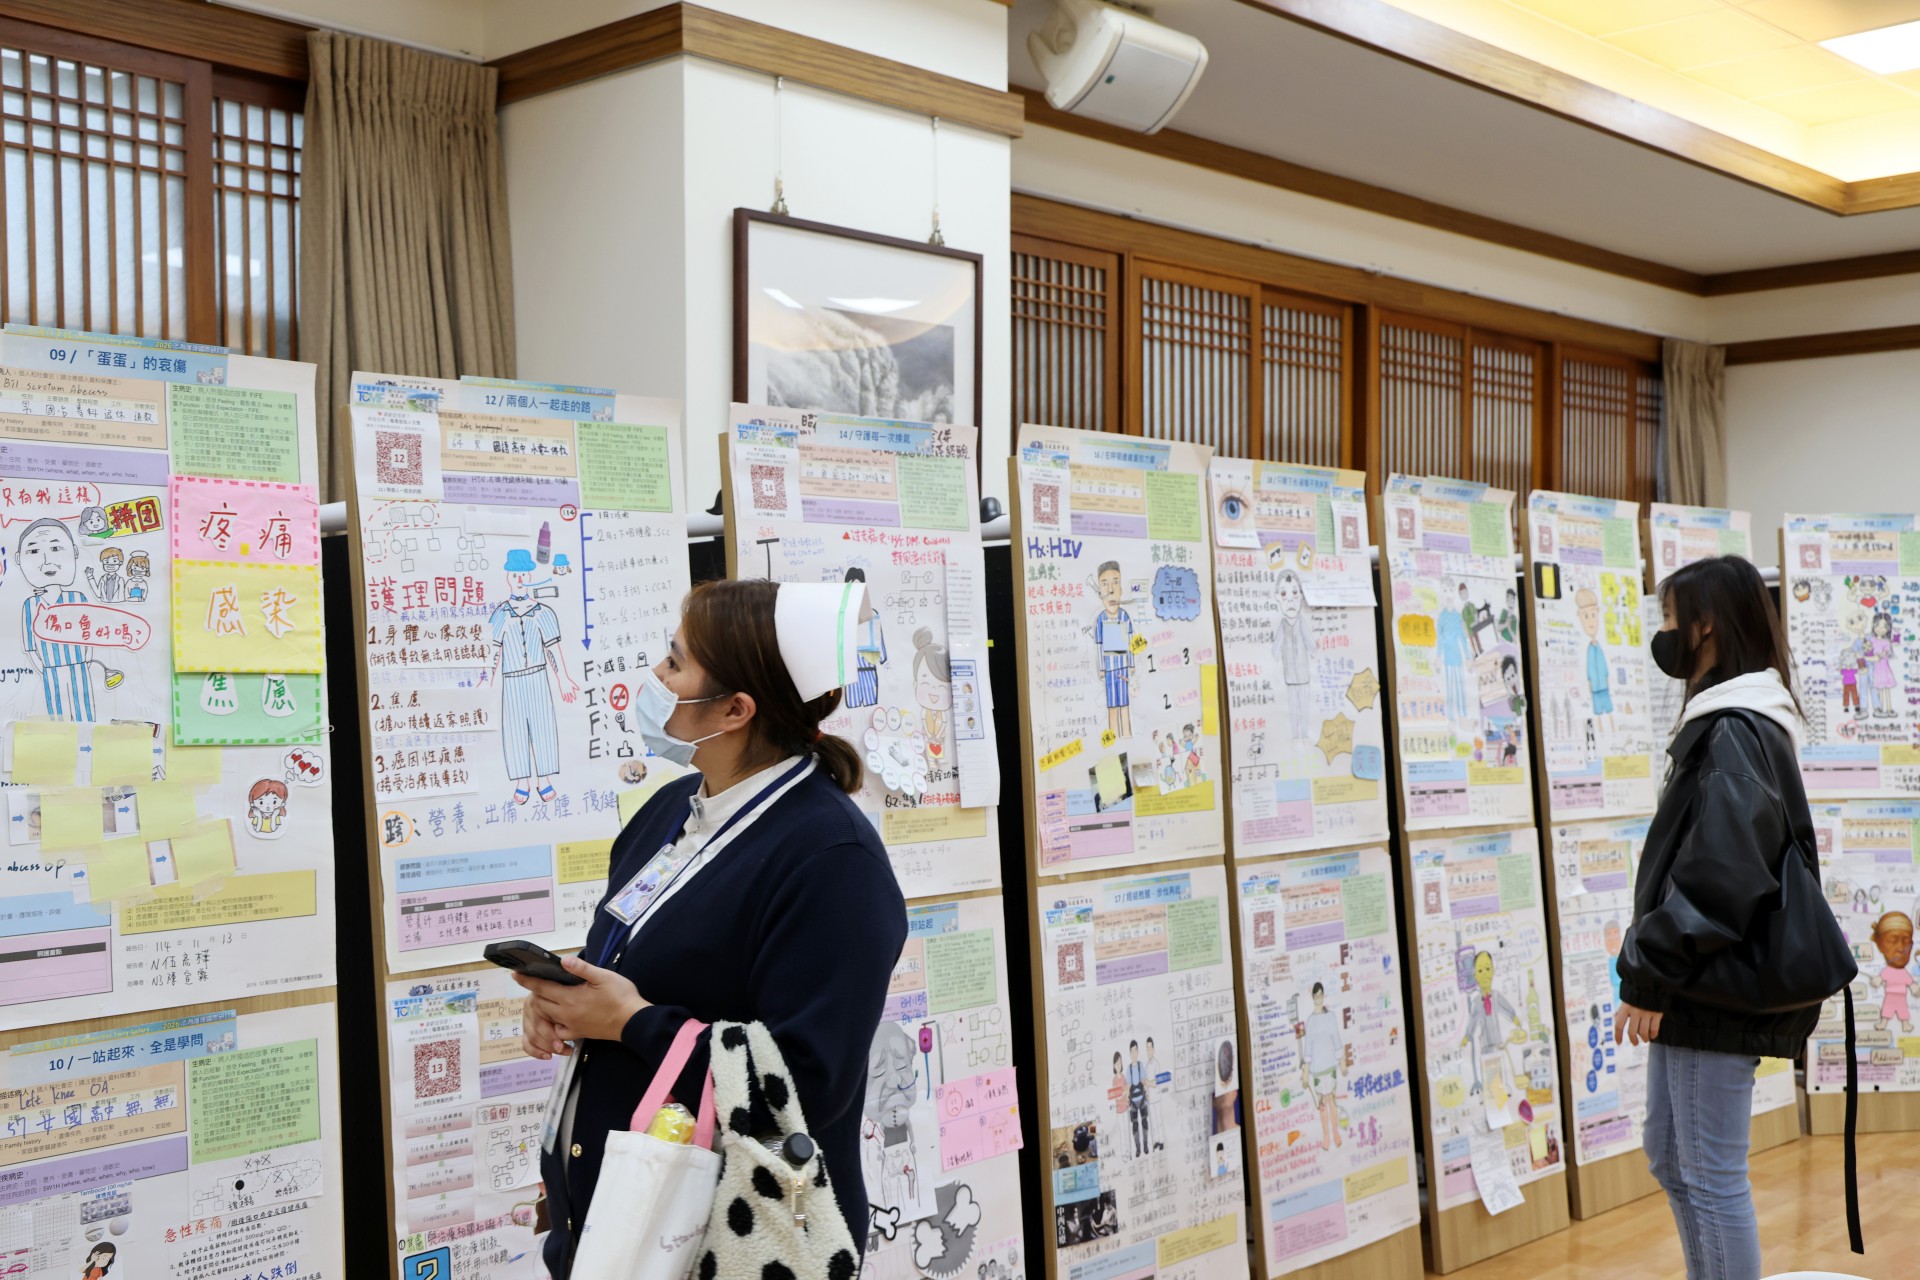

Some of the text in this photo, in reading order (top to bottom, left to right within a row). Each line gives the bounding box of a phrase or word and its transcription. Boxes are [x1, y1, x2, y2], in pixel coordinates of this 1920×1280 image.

[155, 341, 172, 349] 2026
[49, 349, 66, 361] 09
[88, 350, 187, 374] 「蛋蛋」的哀傷
[357, 391, 385, 405] TCMF
[485, 395, 497, 405] 12
[506, 394, 591, 414] 兩個人一起走的路
[839, 431, 848, 440] 14
[394, 454, 405, 463] 12
[765, 483, 773, 492] 14
[200, 502, 292, 559] 疼痛
[1027, 537, 1083, 559] Hx:HIV
[368, 576, 486, 614] 護理問題
[207, 583, 297, 637] 感染
[1148, 654, 1156, 673] 1
[1183, 647, 1190, 665] 3
[1163, 693, 1172, 710] 2
[156, 941, 171, 952] 114
[394, 1004, 423, 1018] TCMF
[163, 1021, 180, 1030] 2026
[490, 1029, 503, 1039] 55
[49, 1058, 65, 1070] 10
[78, 1033, 204, 1064] 一站起來、全是學問
[432, 1063, 443, 1074] 13
[36, 1113, 56, 1135] 女
[5, 1140, 23, 1150] Family
[164, 1216, 222, 1243] 急性疼痛
